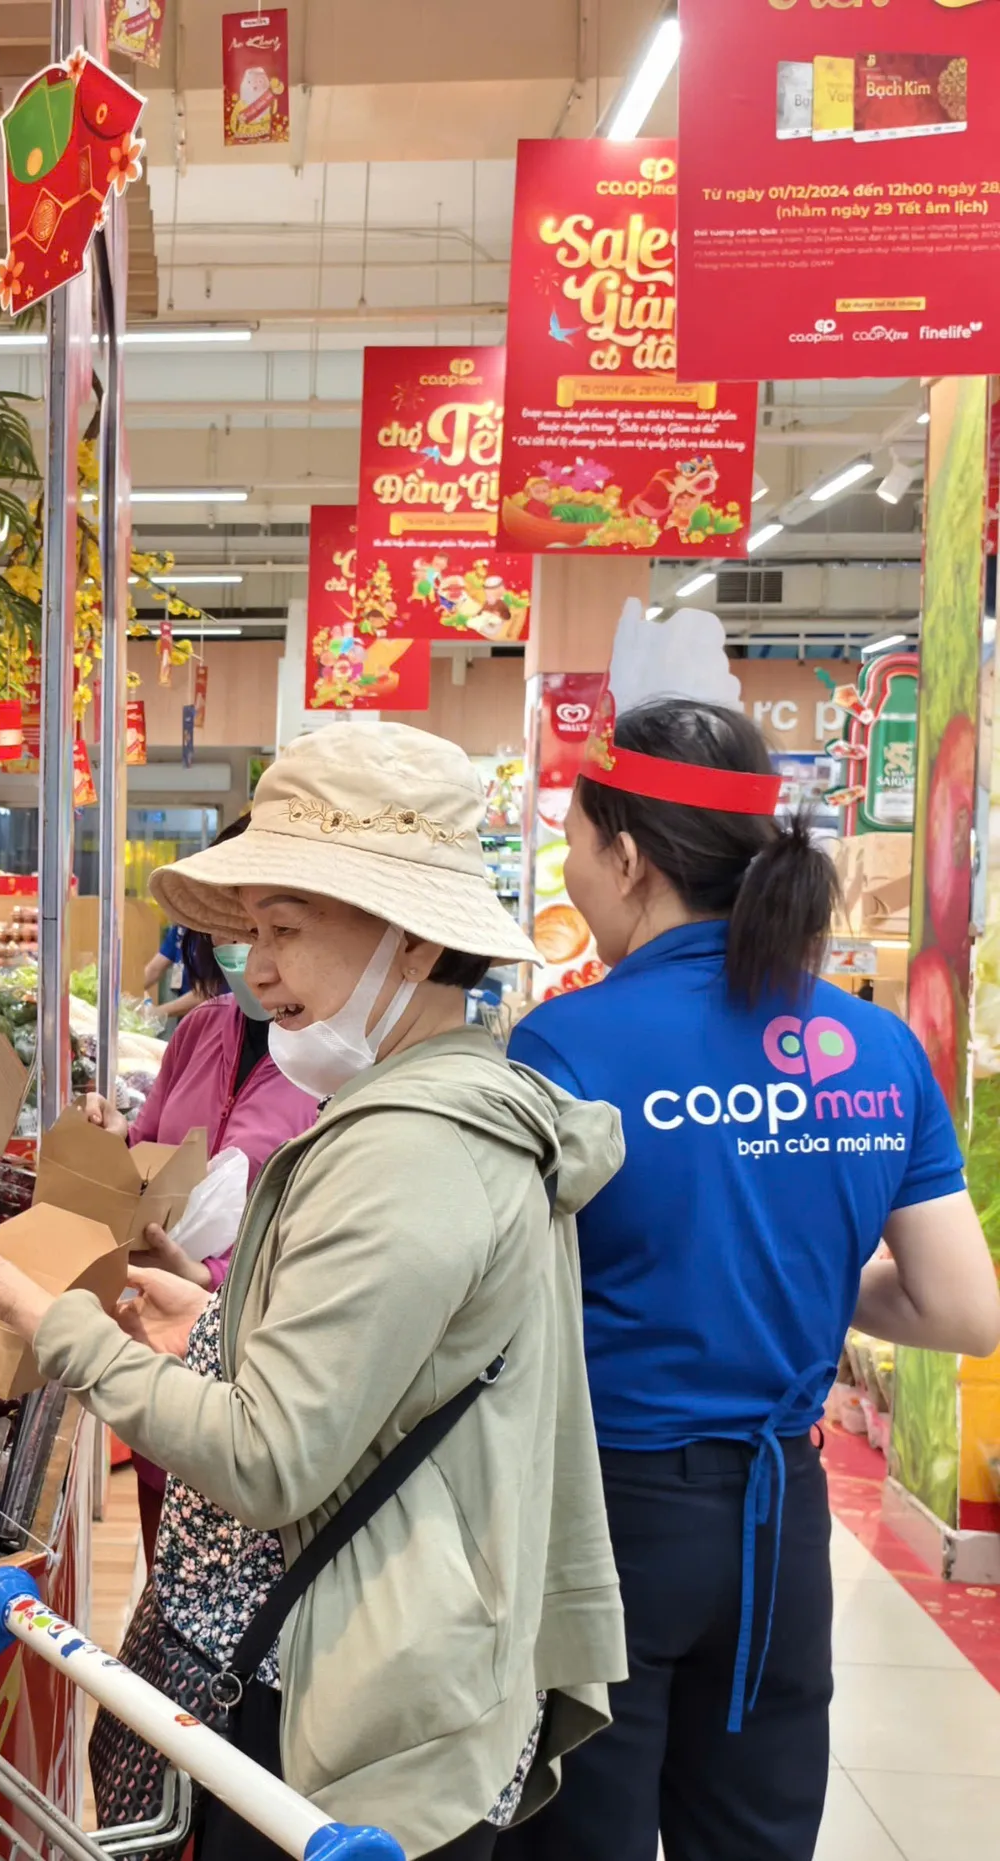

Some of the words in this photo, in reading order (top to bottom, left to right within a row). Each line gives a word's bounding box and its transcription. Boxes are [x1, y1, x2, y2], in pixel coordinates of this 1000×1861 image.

[866, 81, 902, 99] Bạch
[904, 80, 931, 96] Kim
[702, 187, 721, 200] Từ
[726, 187, 764, 202] ngày
[768, 185, 849, 199] 01/12/2024
[853, 183, 883, 197] đến
[888, 183, 933, 196] 12h00
[938, 181, 976, 197] ngày
[831, 203, 870, 219] ngày
[874, 202, 893, 215] 29
[897, 200, 921, 214] Tết
[925, 200, 950, 213] âm
[954, 199, 988, 216] lịch)
[539, 213, 674, 283] Sale
[919, 325, 972, 340] finelife
[589, 345, 621, 370] có
[633, 334, 676, 369] đô
[377, 421, 423, 452] chợ
[372, 469, 461, 513] Đồng
[460, 469, 499, 513] Gi
[737, 1137, 779, 1159] bạn
[784, 1133, 830, 1153] của
[836, 1134, 871, 1156] mọi
[873, 1132, 905, 1152] nhà
